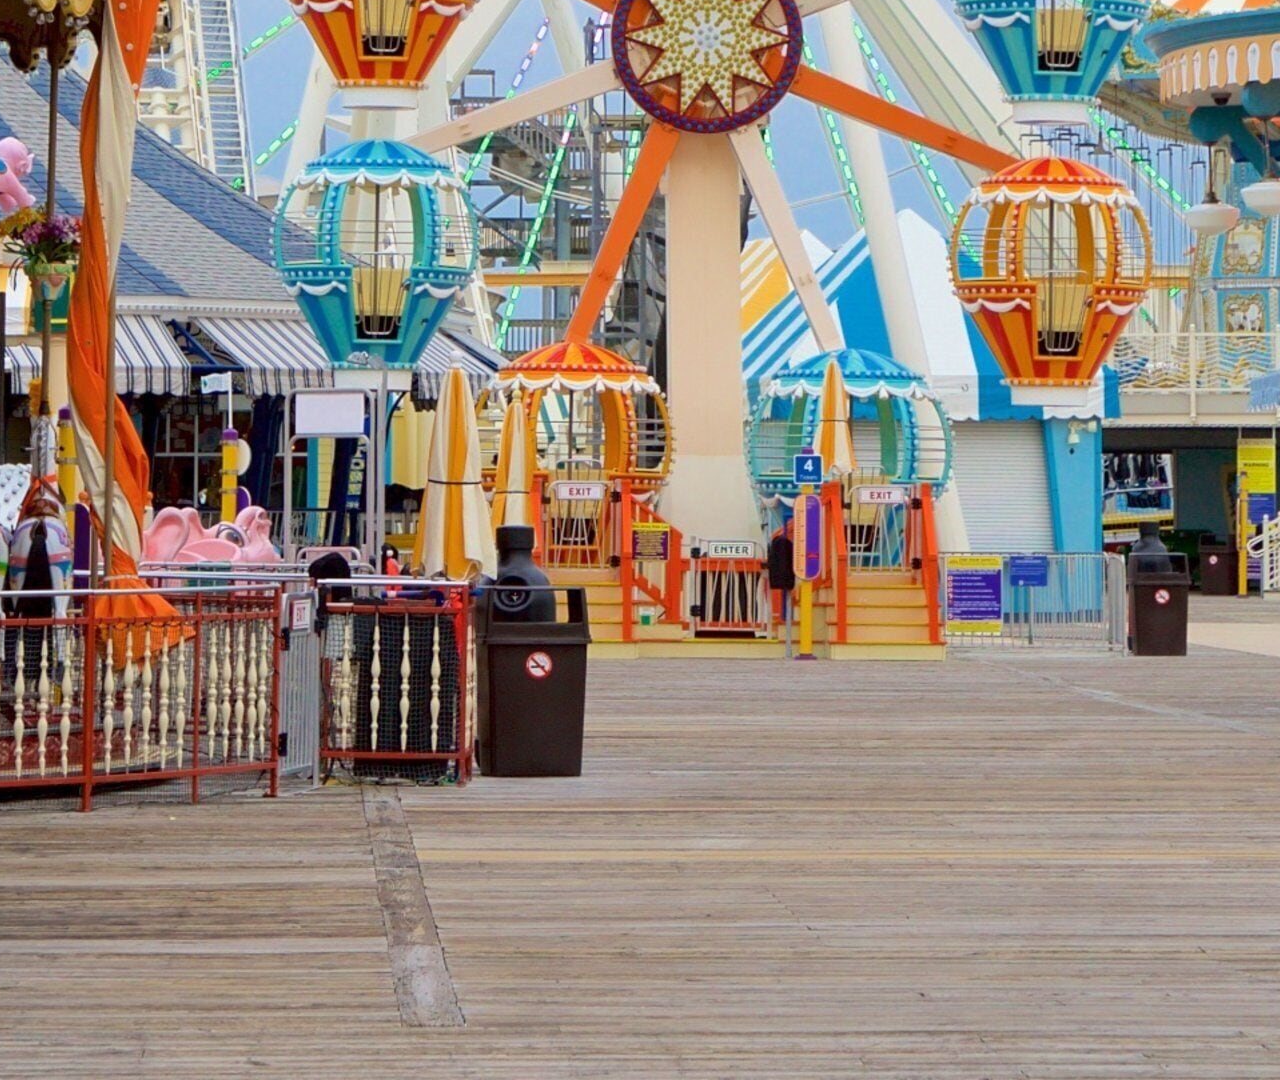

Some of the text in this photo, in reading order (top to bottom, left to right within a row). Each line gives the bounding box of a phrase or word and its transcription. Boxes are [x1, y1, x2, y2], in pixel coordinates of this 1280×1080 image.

[803, 459, 814, 472] 4
[568, 487, 592, 497] EXIT
[869, 490, 893, 500] EXIT
[713, 545, 751, 556] ENTER
